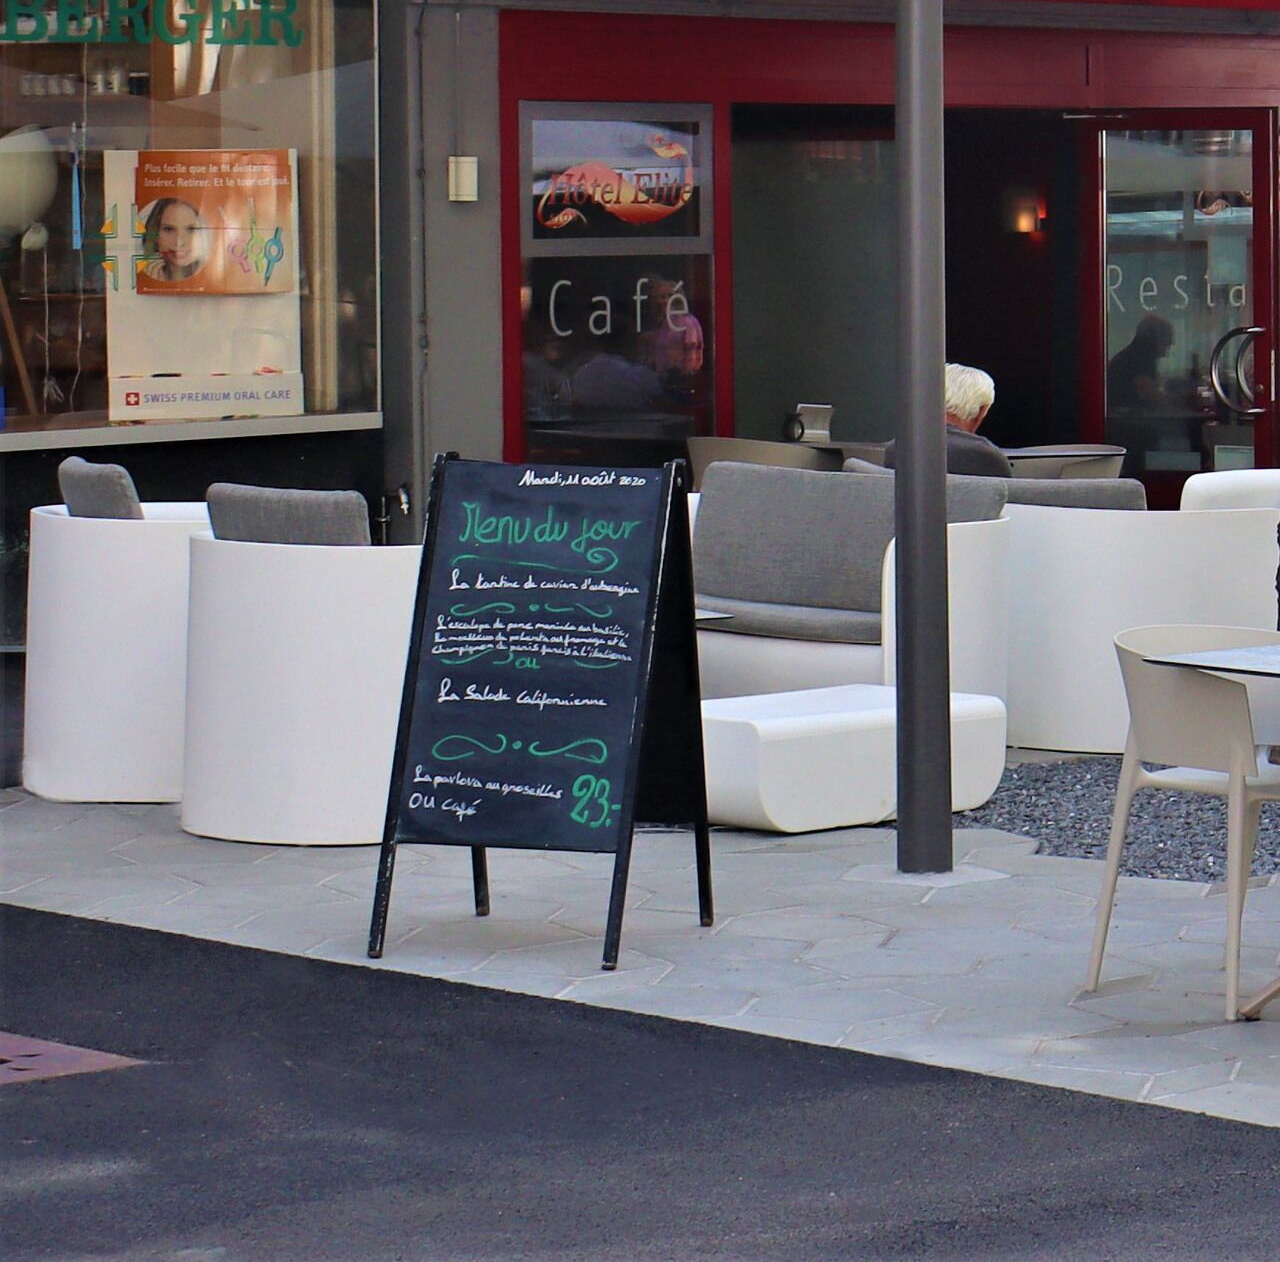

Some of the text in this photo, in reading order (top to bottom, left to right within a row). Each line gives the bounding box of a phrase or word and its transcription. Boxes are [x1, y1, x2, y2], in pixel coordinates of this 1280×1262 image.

[549, 172, 694, 206] Hôtel Elite
[549, 278, 689, 337] Café
[144, 389, 292, 404] SWISS PREMIUM ORAL CARE
[619, 475, 647, 486] 2020
[459, 501, 643, 552] Menu du jour
